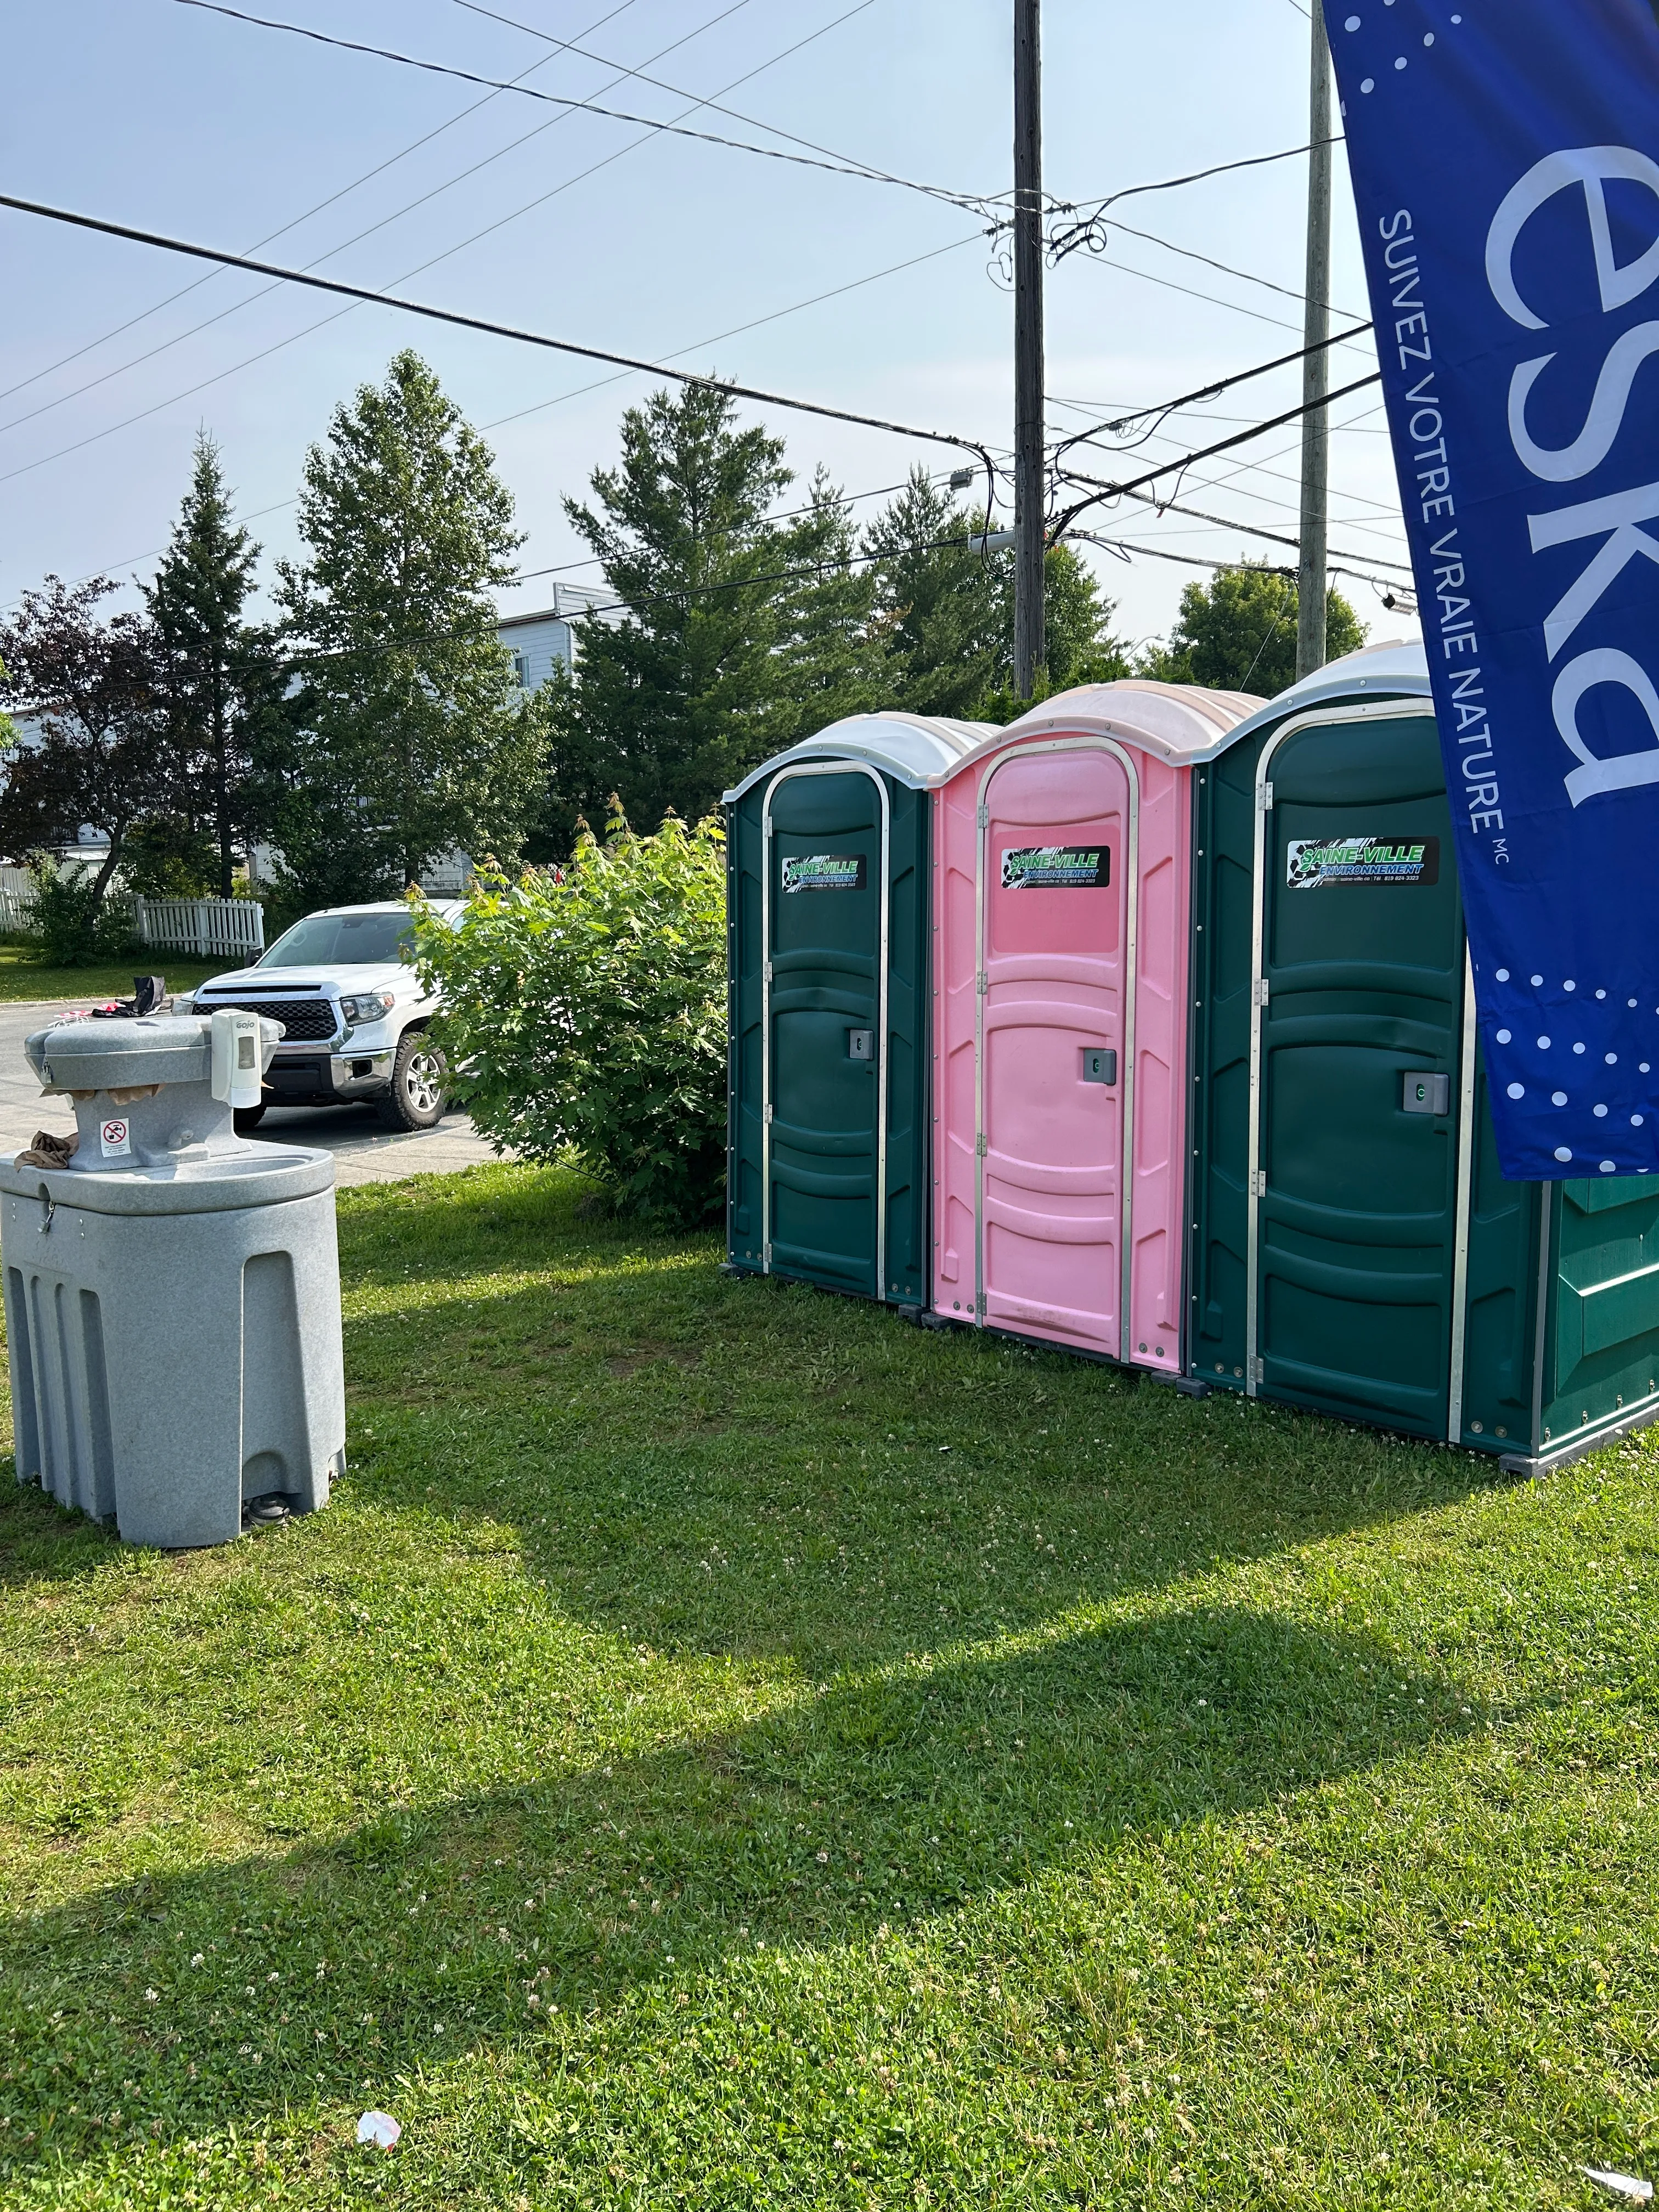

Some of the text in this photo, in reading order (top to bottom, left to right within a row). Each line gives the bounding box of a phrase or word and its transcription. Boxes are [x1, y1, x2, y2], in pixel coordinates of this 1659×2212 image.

[1379, 208, 1509, 865] SUIVEZ VOTRE VRAIE NATURE MC
[1011, 854, 1099, 870] SAINE-VILLE
[1302, 845, 1425, 865] SAINE-VILLE
[788, 861, 859, 876] SAINE-VILLE
[1023, 869, 1099, 879] ENVIRONNEMENT
[1318, 864, 1425, 876] ENVIRONNEMENT
[798, 874, 859, 884] ENVIRONNEMENT
